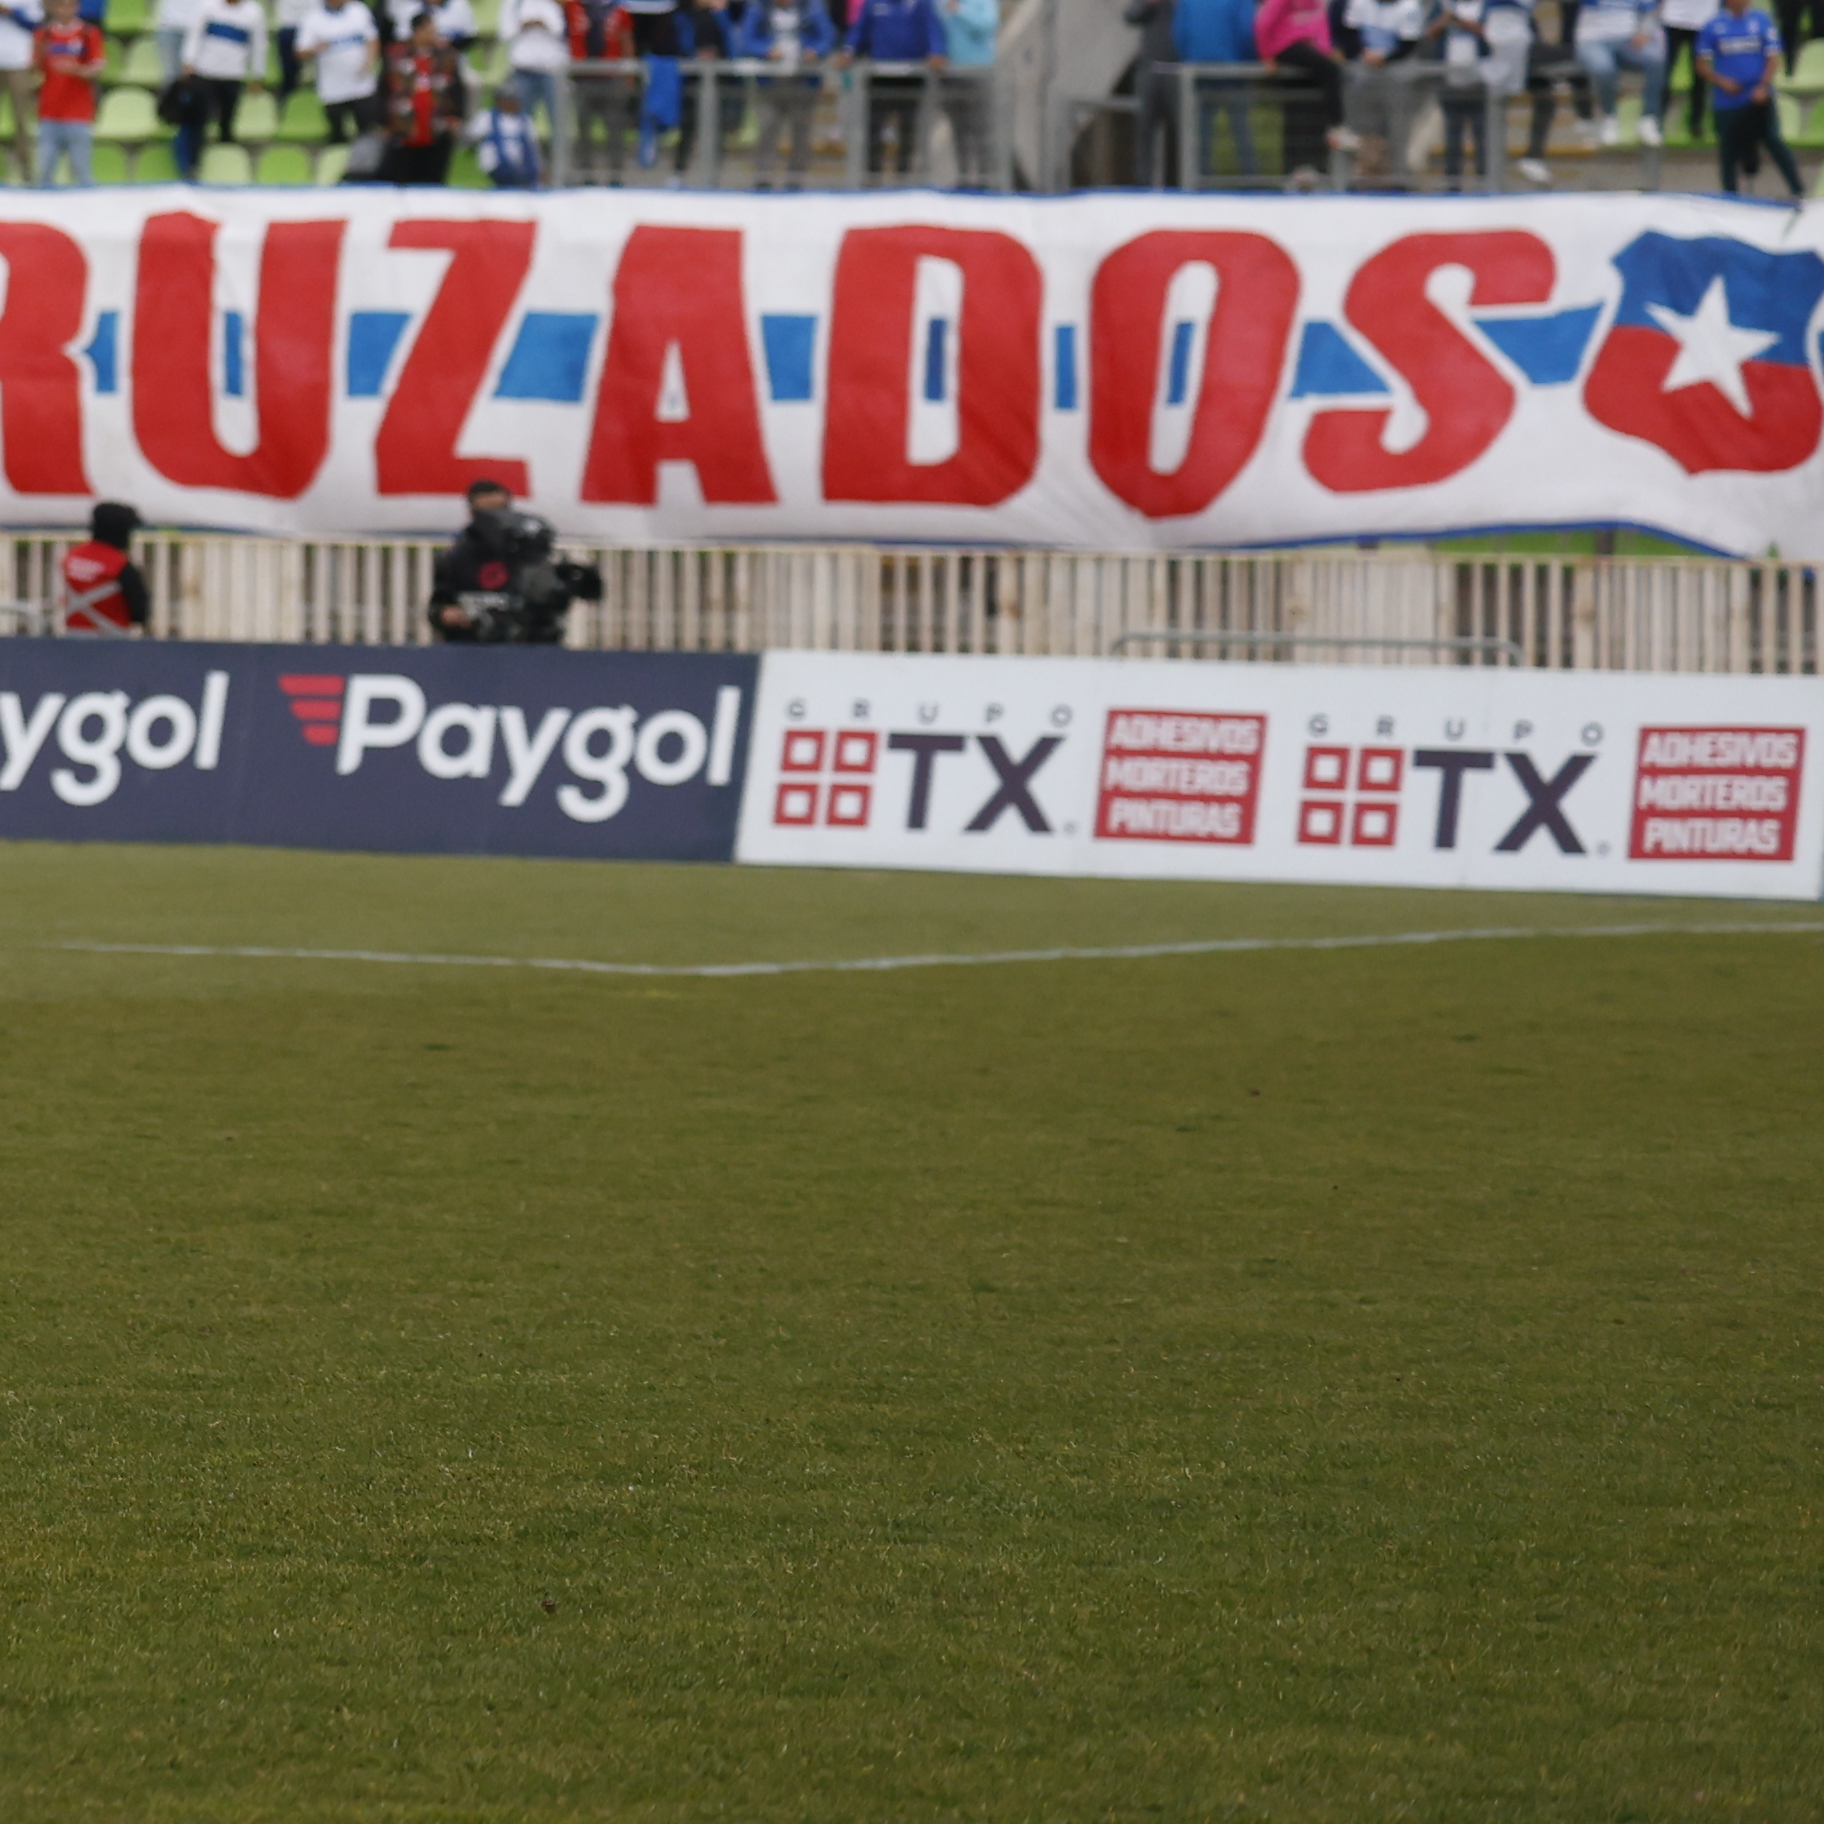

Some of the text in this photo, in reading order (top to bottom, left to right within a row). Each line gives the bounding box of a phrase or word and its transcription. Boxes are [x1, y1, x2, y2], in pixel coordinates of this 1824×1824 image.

[336, 673, 741, 823] Paygol
[1109, 716, 1259, 754] ADHESIVOS
[1641, 732, 1798, 769] ADHESIVOS
[888, 732, 1067, 835] TX
[1106, 756, 1249, 796] MORTEROS
[1639, 776, 1787, 813] MORTEROS
[1107, 801, 1242, 838] PINTURAS
[1412, 748, 1598, 854] TX
[1643, 818, 1781, 854] PINTURAS
